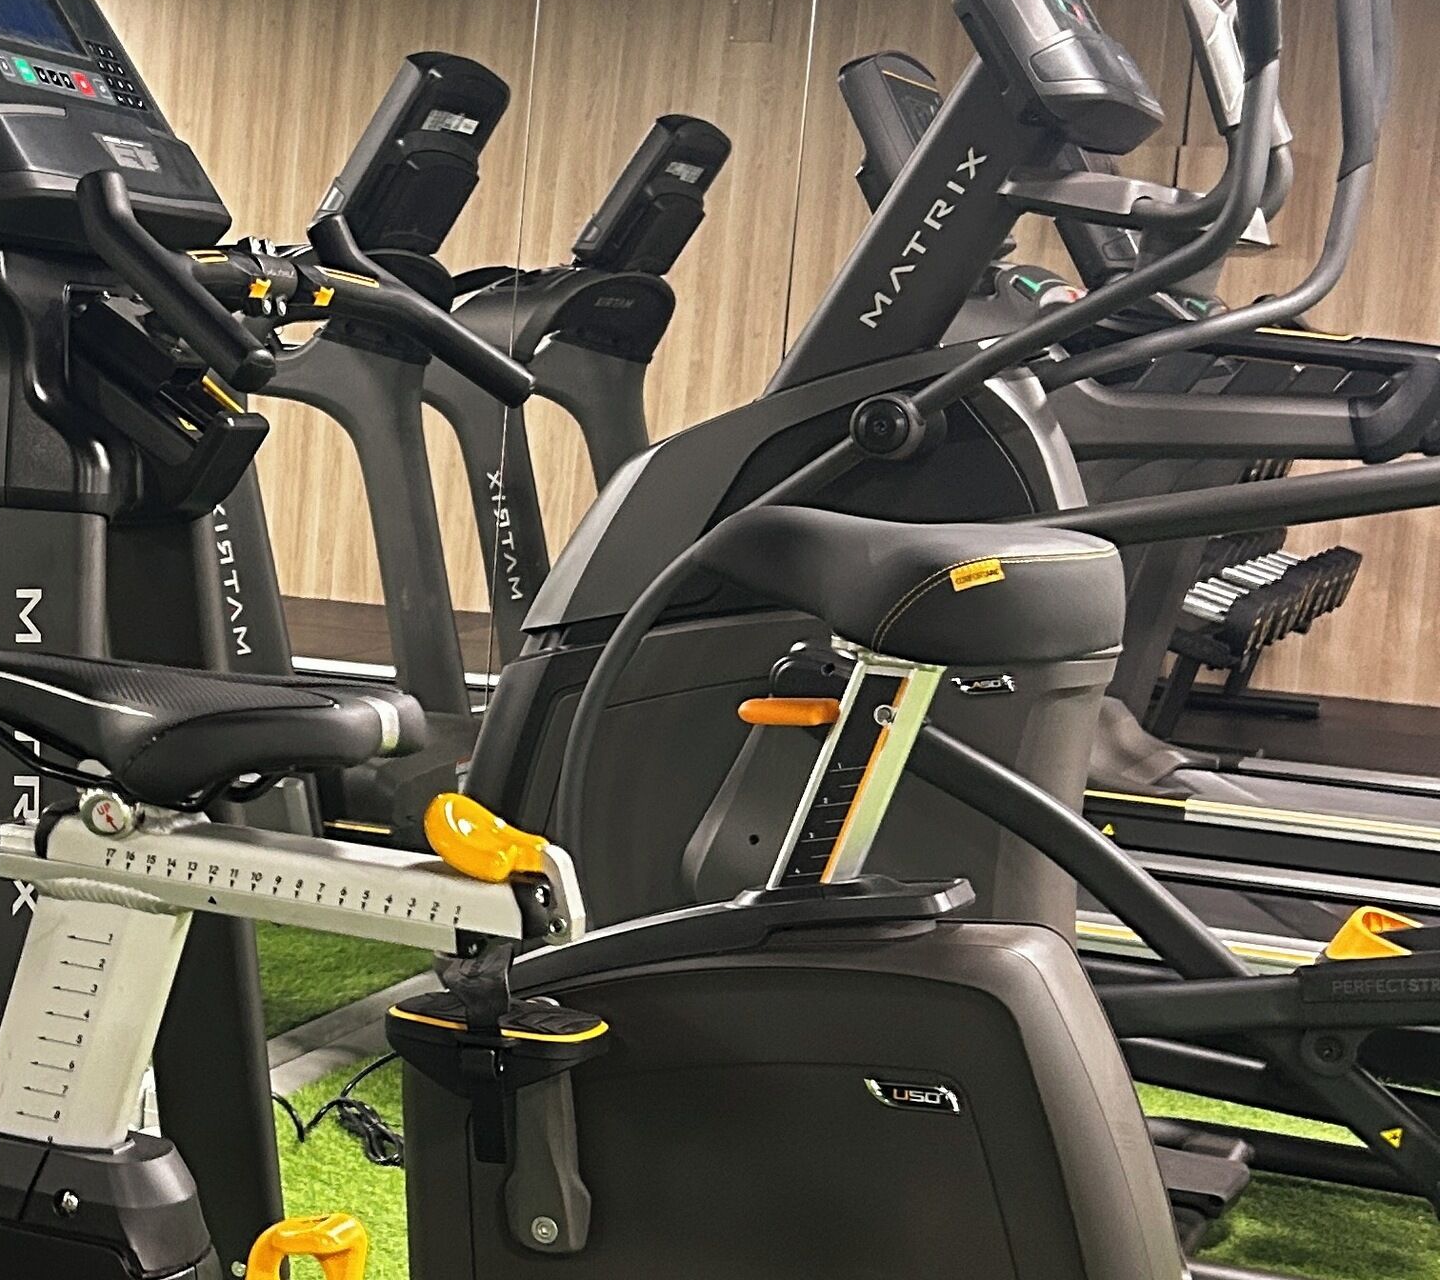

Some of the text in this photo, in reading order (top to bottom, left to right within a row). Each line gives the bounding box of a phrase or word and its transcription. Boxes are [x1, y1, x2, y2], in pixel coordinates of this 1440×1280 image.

[860, 147, 988, 328] MATRIX
[97, 803, 110, 815] UP
[107, 848, 117, 857] 17
[126, 851, 136, 861] 16
[146, 854, 157, 864] 15
[167, 858, 177, 868] 14
[188, 862, 198, 871] 13
[209, 865, 220, 875] 12
[251, 872, 262, 882] 10
